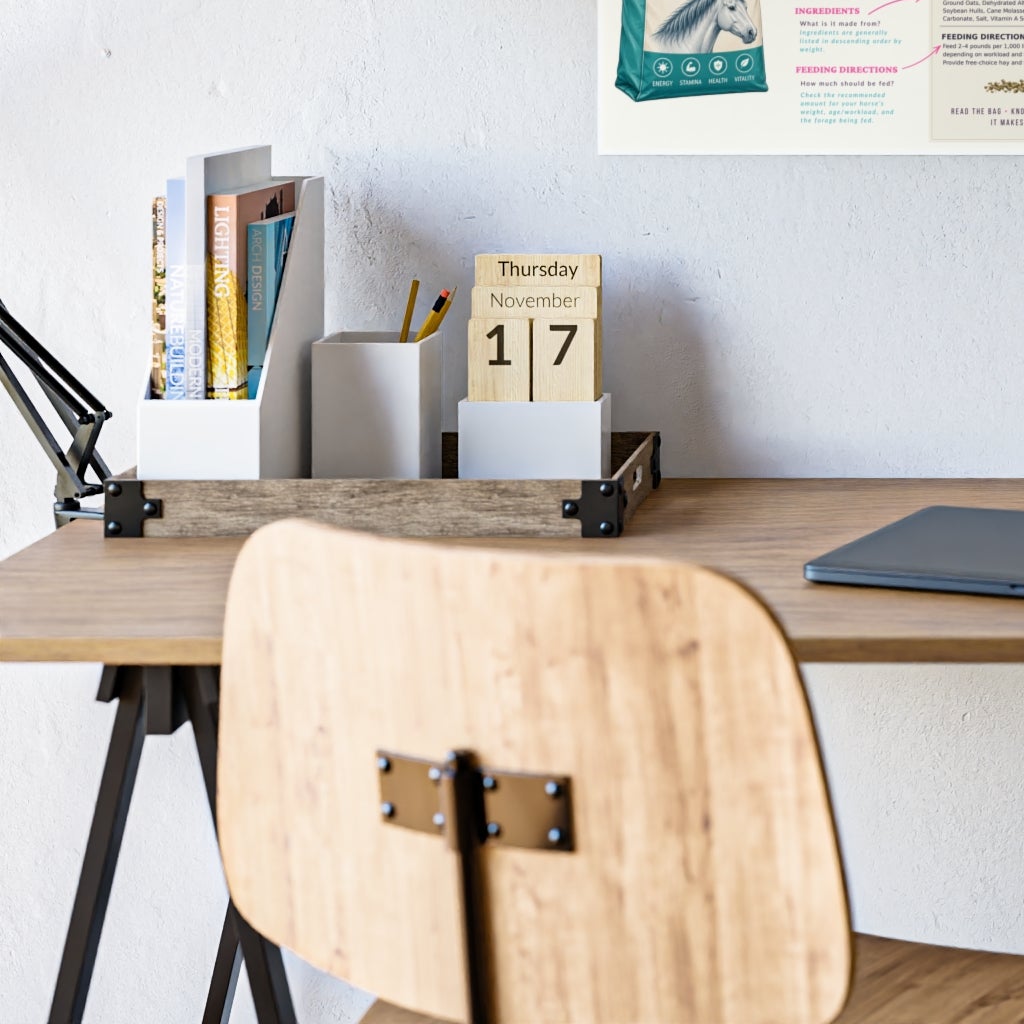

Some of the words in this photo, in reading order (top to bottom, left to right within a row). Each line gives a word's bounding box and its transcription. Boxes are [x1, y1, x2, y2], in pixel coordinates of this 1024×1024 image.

[795, 7, 860, 15] INGREDIENTS
[795, 66, 837, 74] FEEDING
[839, 66, 898, 74] DIRECTIONS
[998, 59, 1010, 67] hay
[950, 107, 969, 116] READ
[972, 107, 984, 115] THE
[987, 107, 1001, 115] BAG
[213, 206, 230, 299] LIGHTING
[251, 229, 263, 262] ARCH
[497, 260, 579, 280] Thursday
[251, 265, 263, 311] DESIGN
[490, 292, 580, 309] November
[486, 325, 512, 366] 1
[549, 325, 578, 366] 7
[188, 329, 202, 398] MODERN
